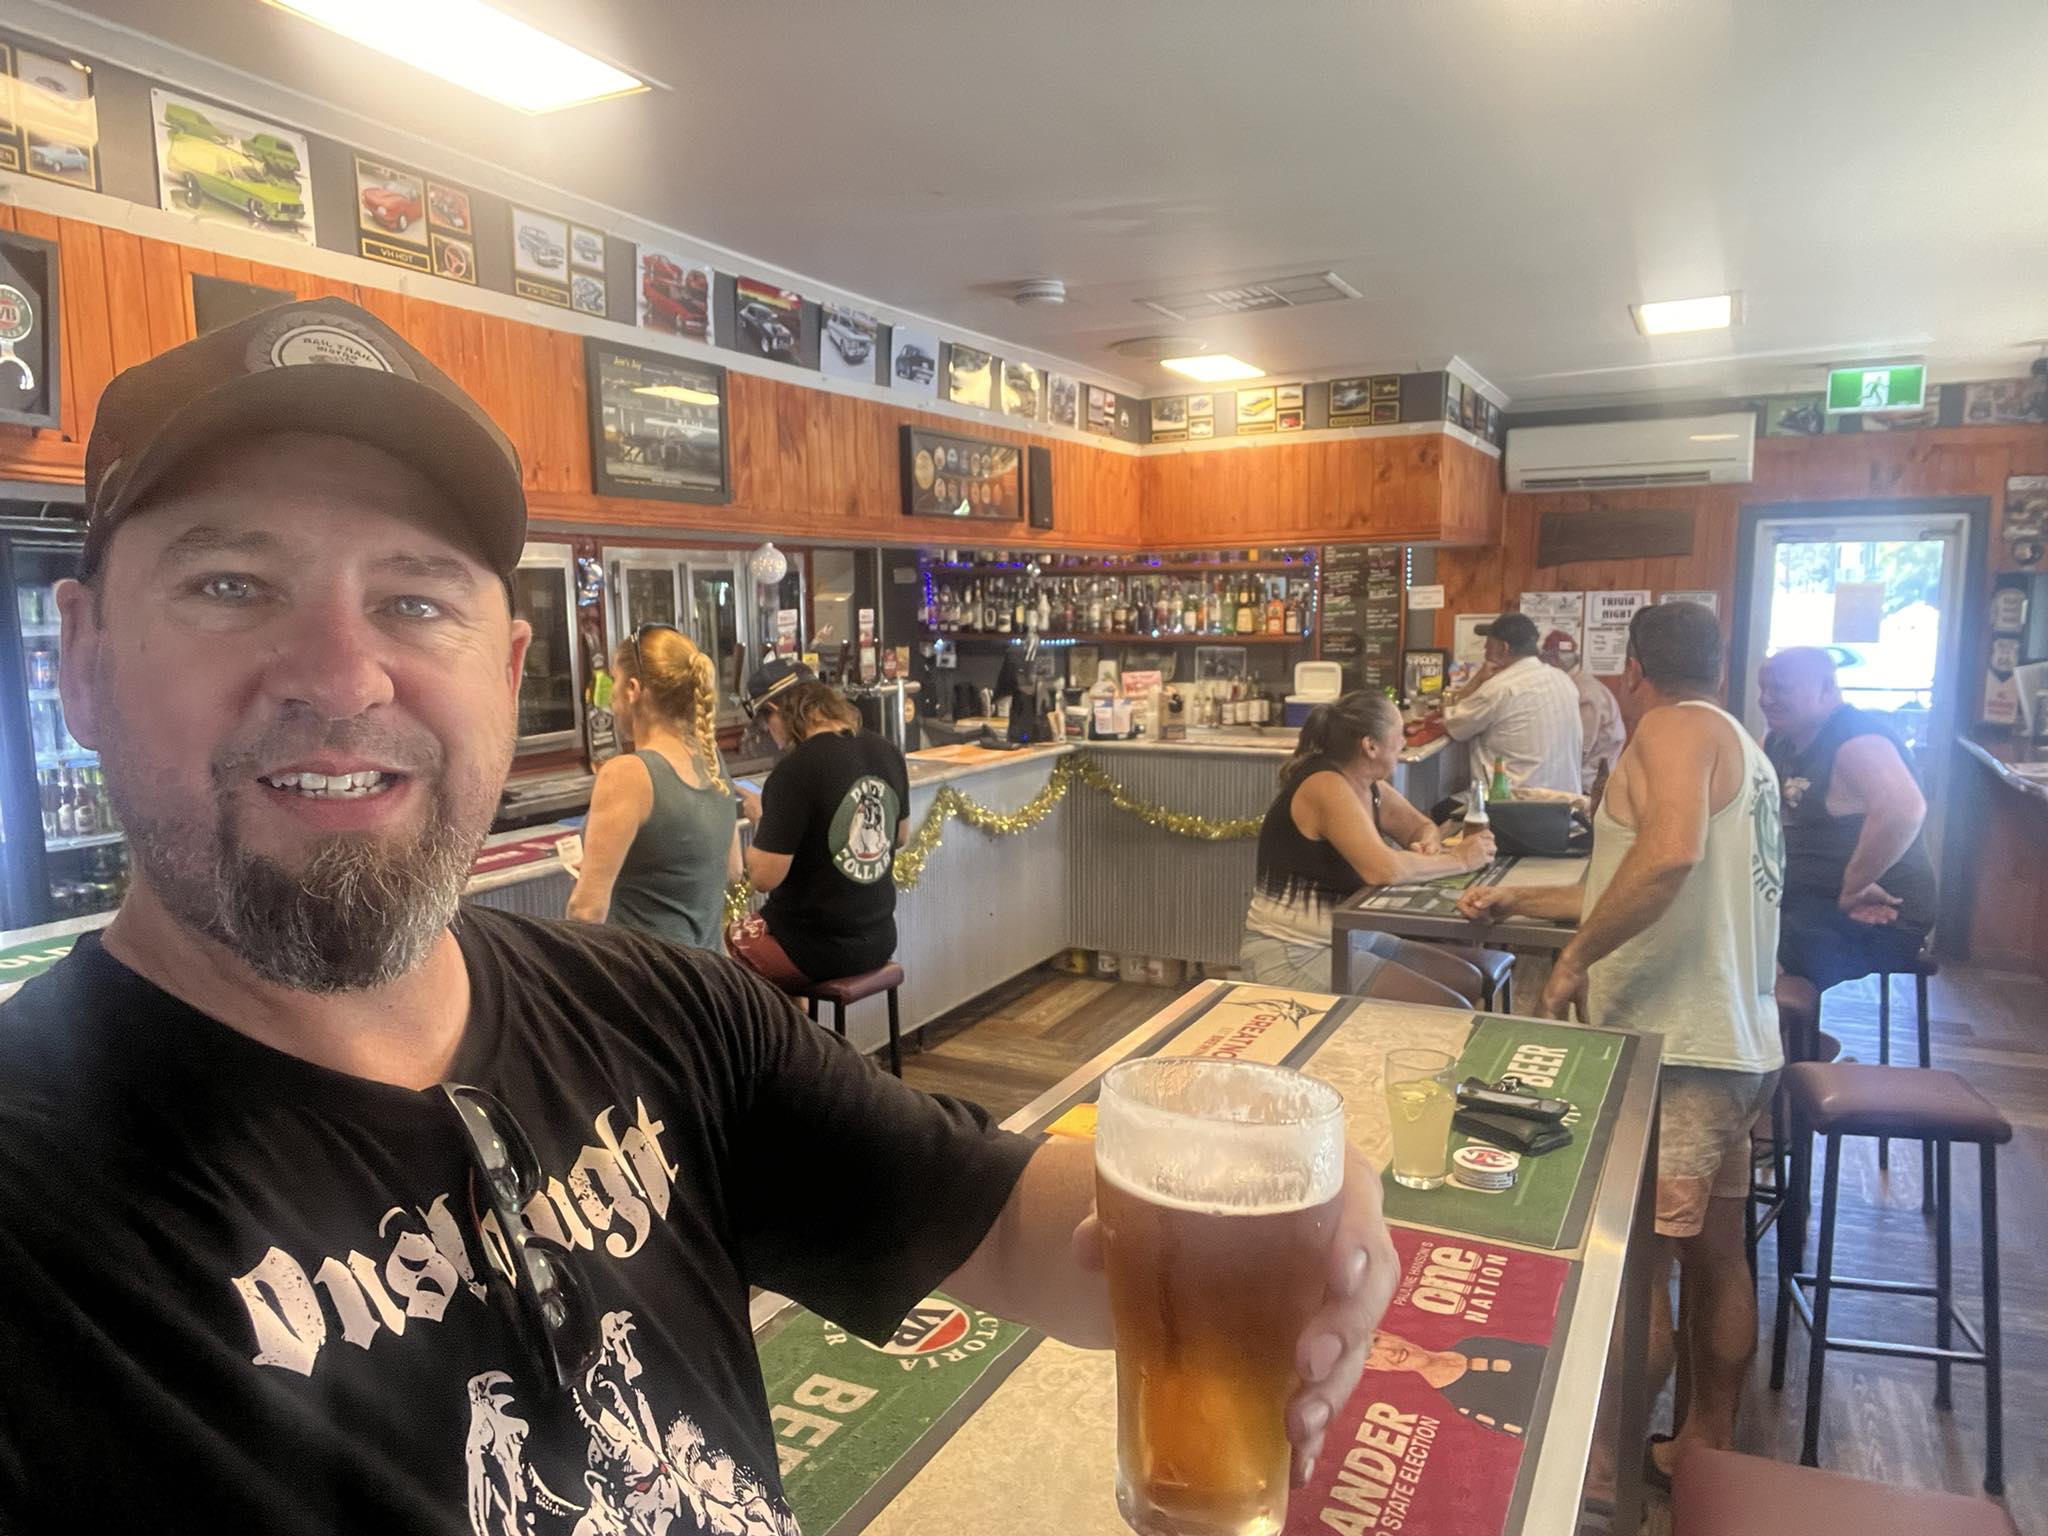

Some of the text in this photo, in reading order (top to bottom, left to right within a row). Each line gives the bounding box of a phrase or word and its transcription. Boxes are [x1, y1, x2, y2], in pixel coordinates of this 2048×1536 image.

[1602, 597, 1635, 606] TRIVIA
[1602, 609, 1632, 619] NIGHT
[1500, 1044, 1568, 1088] BEER
[1464, 1254, 1508, 1324] NATION
[899, 1312, 999, 1372] CTORIA
[1381, 1482, 1415, 1530] STATE
[1400, 1415, 1440, 1484] ELECTION
